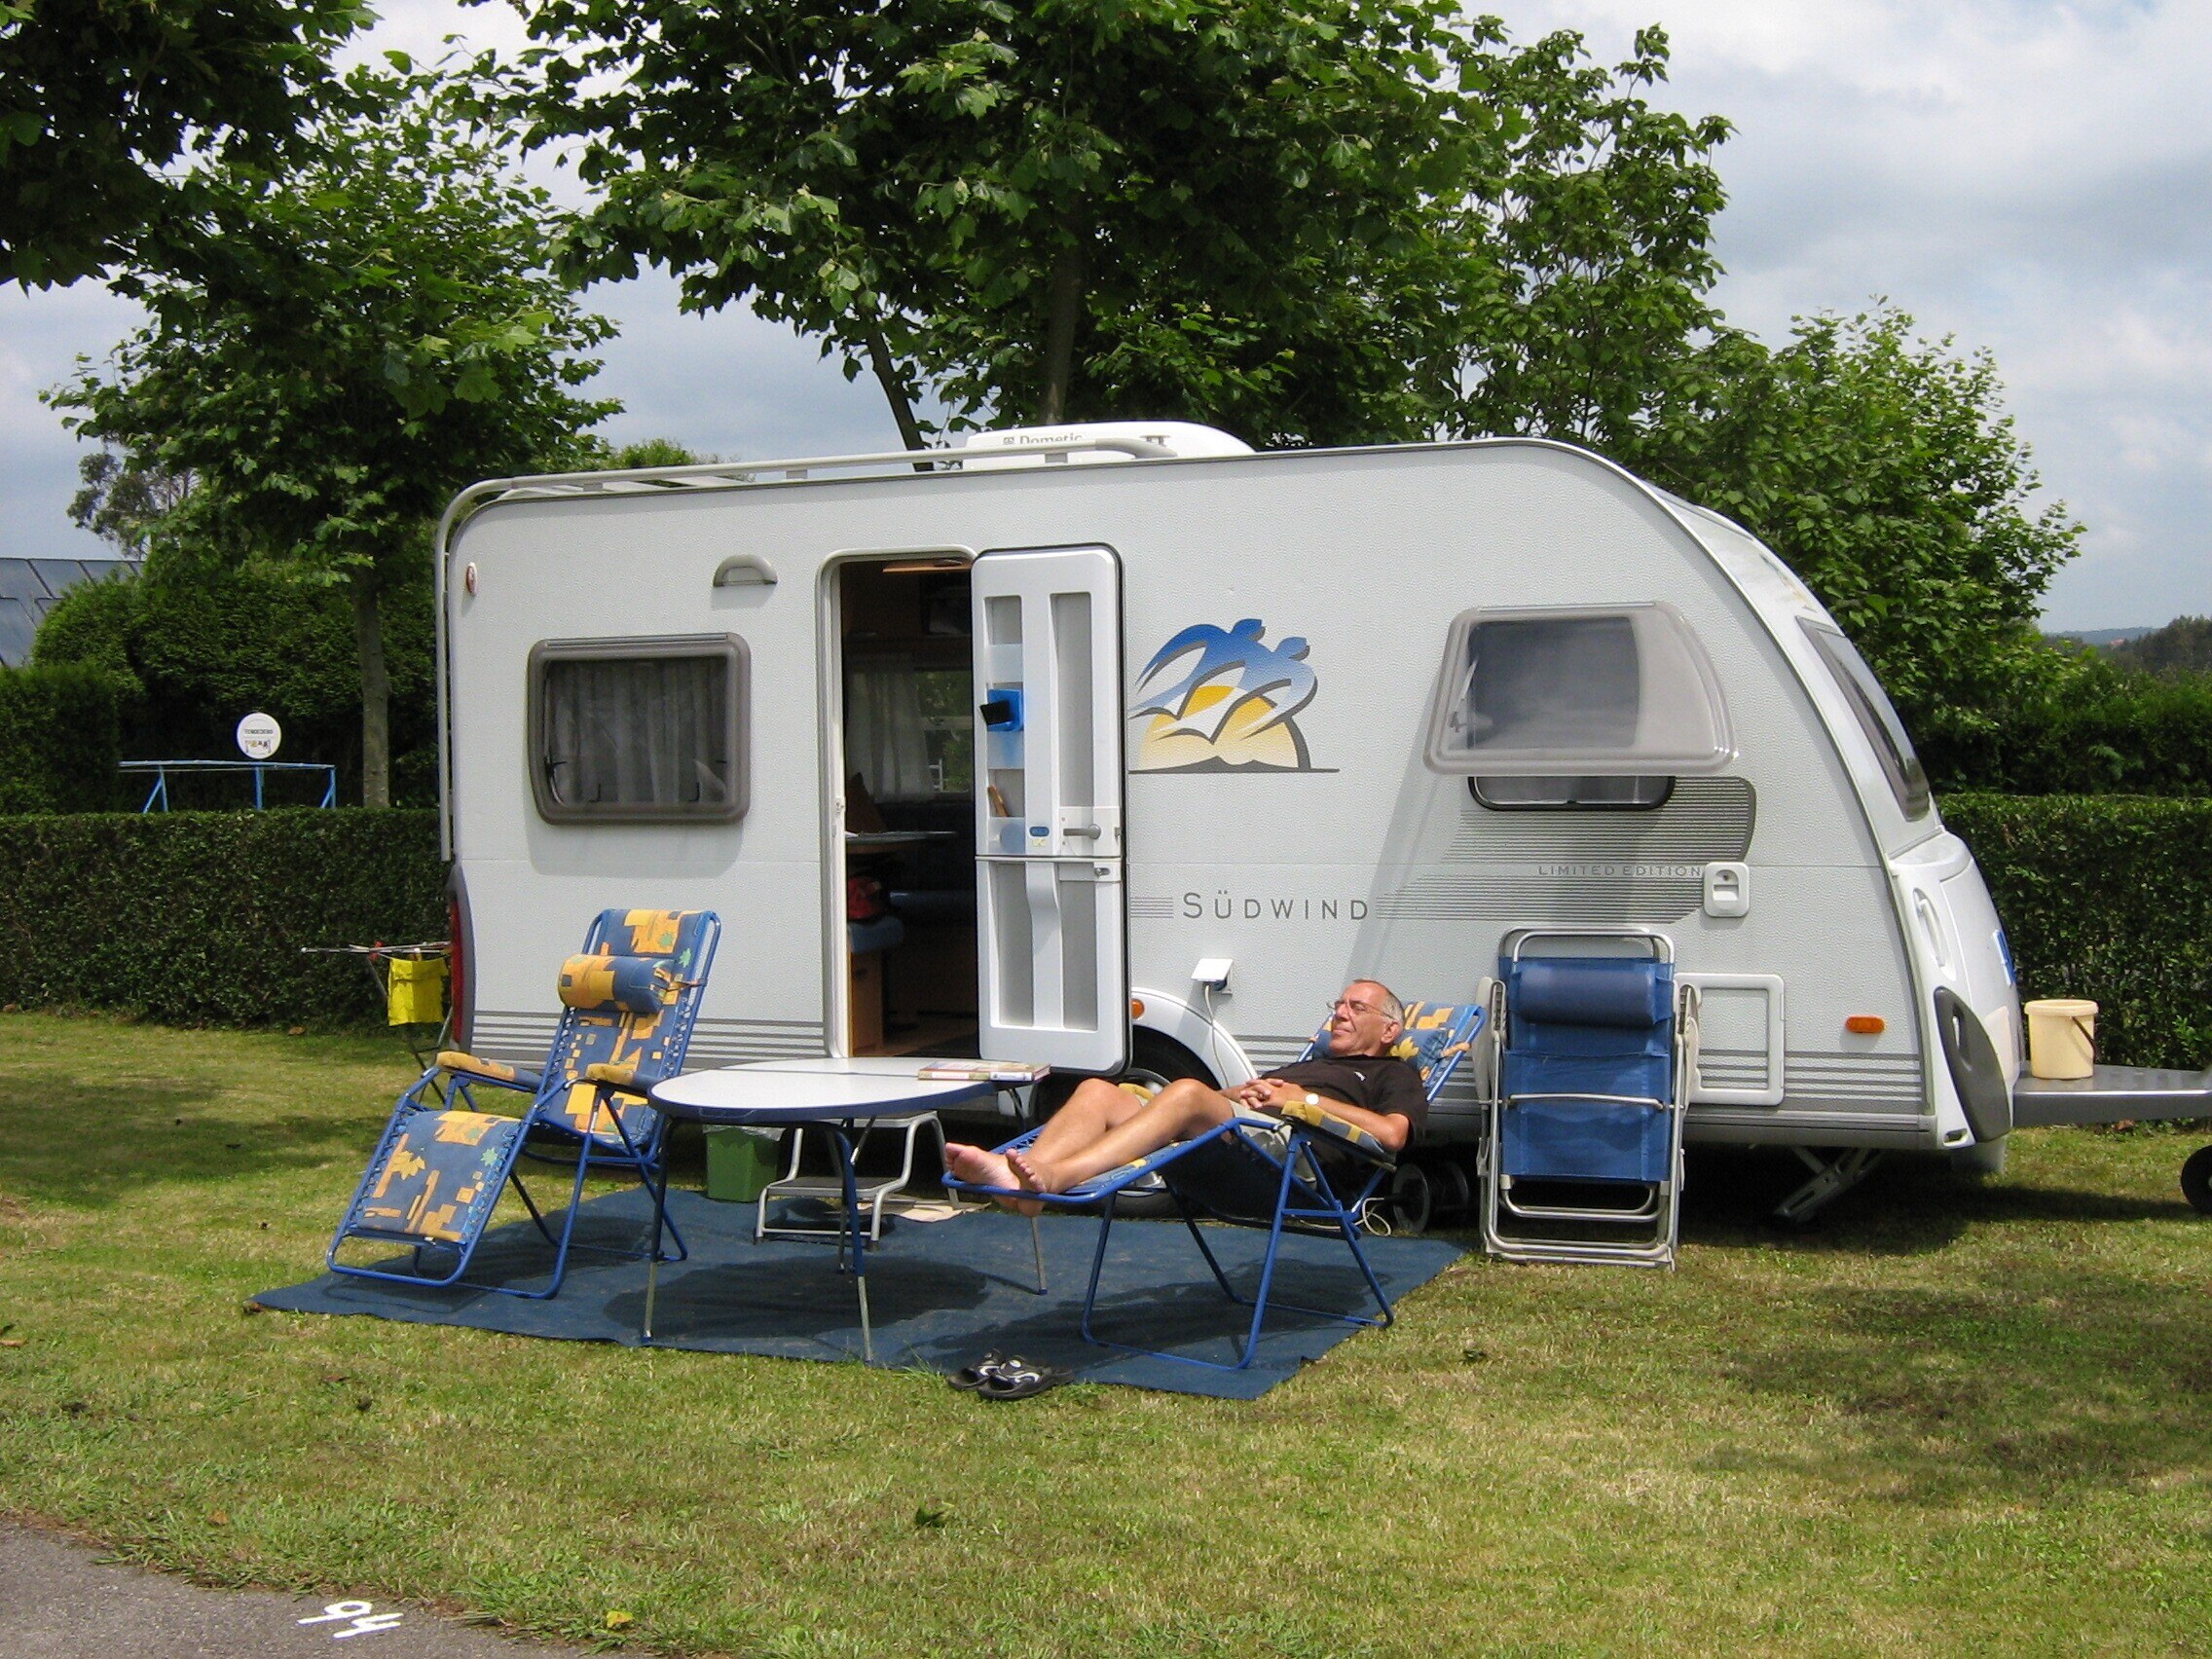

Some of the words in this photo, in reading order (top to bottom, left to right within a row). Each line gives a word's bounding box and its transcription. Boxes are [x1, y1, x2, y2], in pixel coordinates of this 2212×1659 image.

[1538, 865, 1615, 876] LIMITED
[1622, 865, 1703, 877] EDITION
[1182, 889, 1368, 920] SÜDWIND
